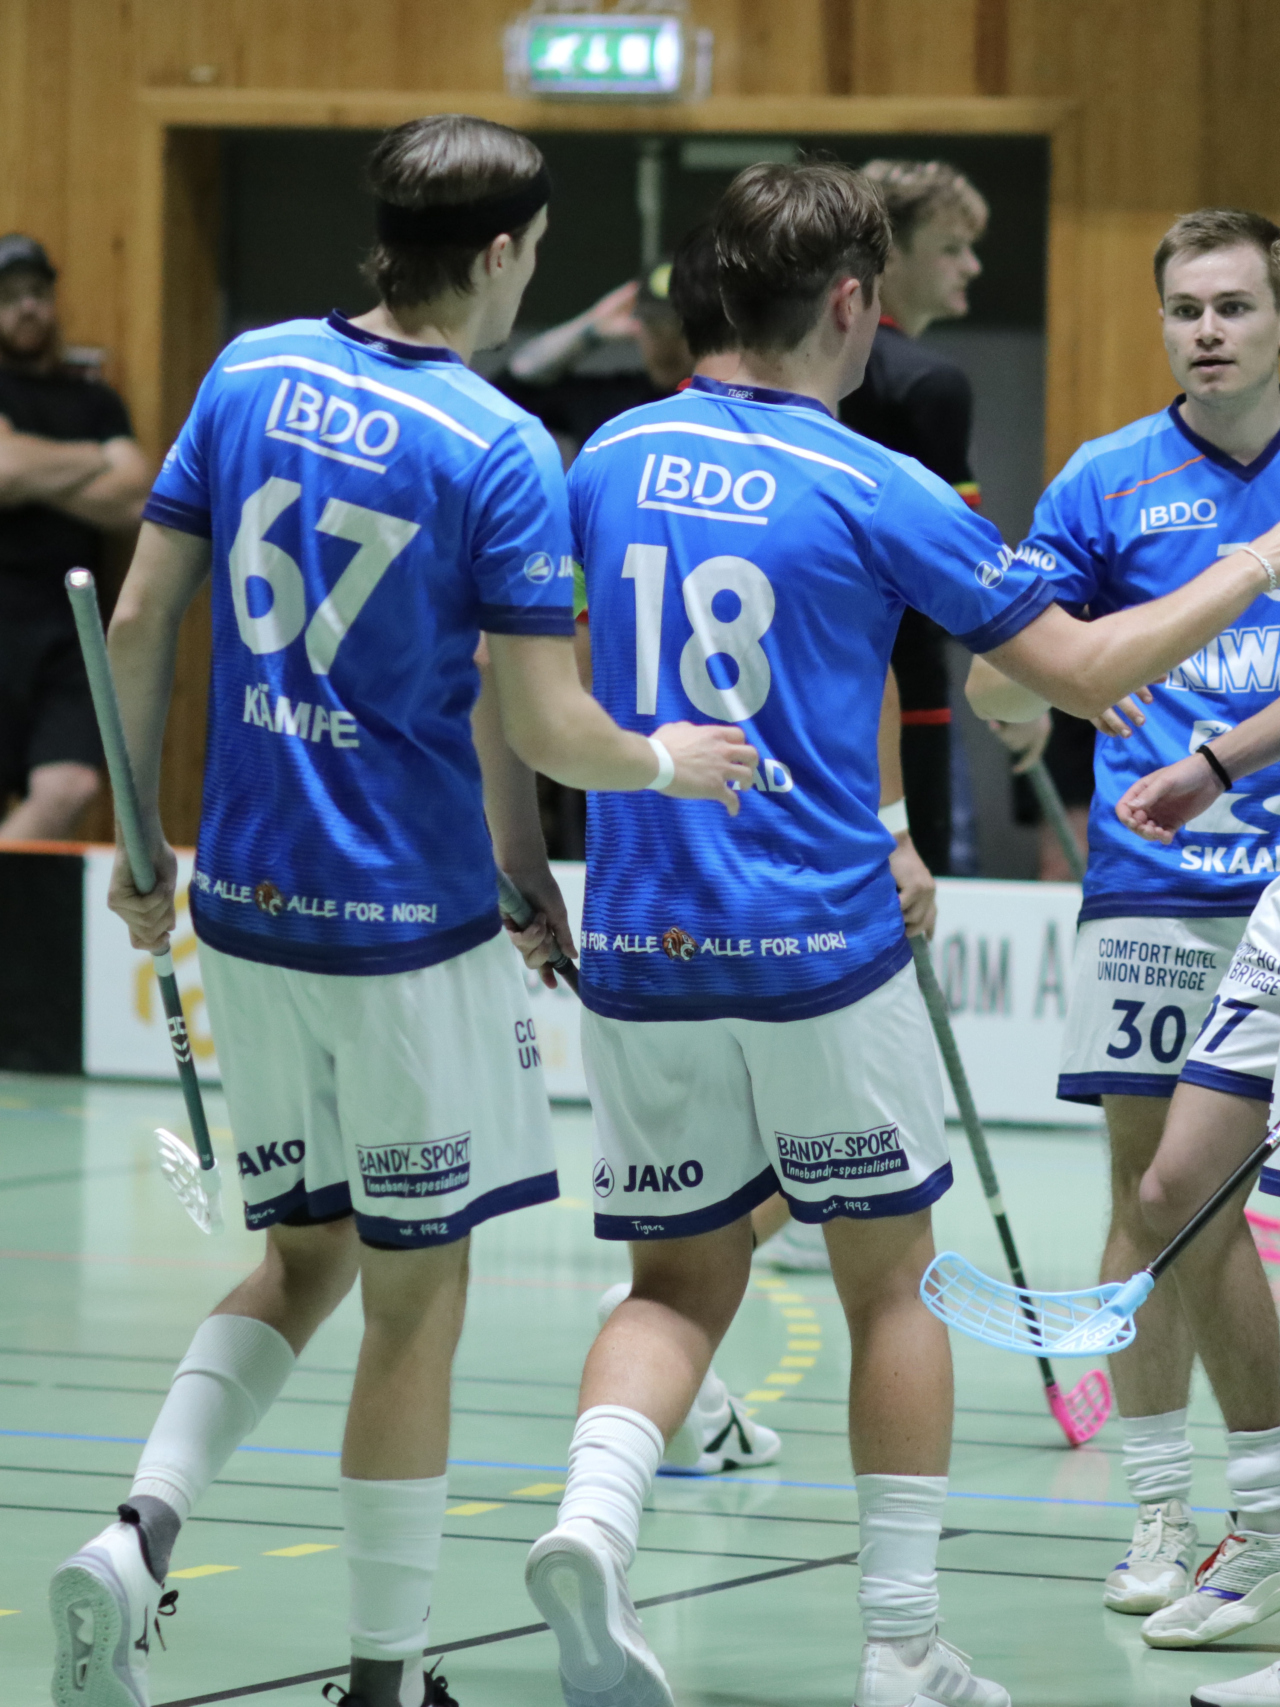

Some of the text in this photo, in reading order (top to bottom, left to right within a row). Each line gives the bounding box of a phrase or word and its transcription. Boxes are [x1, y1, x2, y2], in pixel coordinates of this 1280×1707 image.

[286, 380, 400, 457] BDO
[655, 454, 777, 512] BDO
[1150, 498, 1217, 528] BDO
[228, 475, 422, 676] 67
[620, 542, 776, 724] 18
[242, 683, 361, 749] KÄMPE
[213, 879, 252, 904] ALLE
[287, 895, 339, 918] ALLE
[344, 901, 386, 922] FOR
[392, 902, 438, 924] NOR!
[588, 932, 608, 951] FOR
[612, 934, 660, 953] ALLE
[701, 937, 754, 957] ALLE
[760, 938, 801, 957] FOR
[807, 930, 847, 953] NOR!
[1098, 937, 1217, 970] COMFORT HOTEL
[1097, 960, 1207, 991] UNION BRYGGE
[1105, 998, 1188, 1065] 30
[357, 1136, 471, 1174] BANDY-SPORT
[777, 1126, 901, 1163] BANDY-SPORT
[623, 1159, 704, 1193] JAKO
[786, 1157, 902, 1180] Innebandy-spesialisten
[843, 1200, 871, 1212] 1992
[631, 1220, 665, 1235] Tigers
